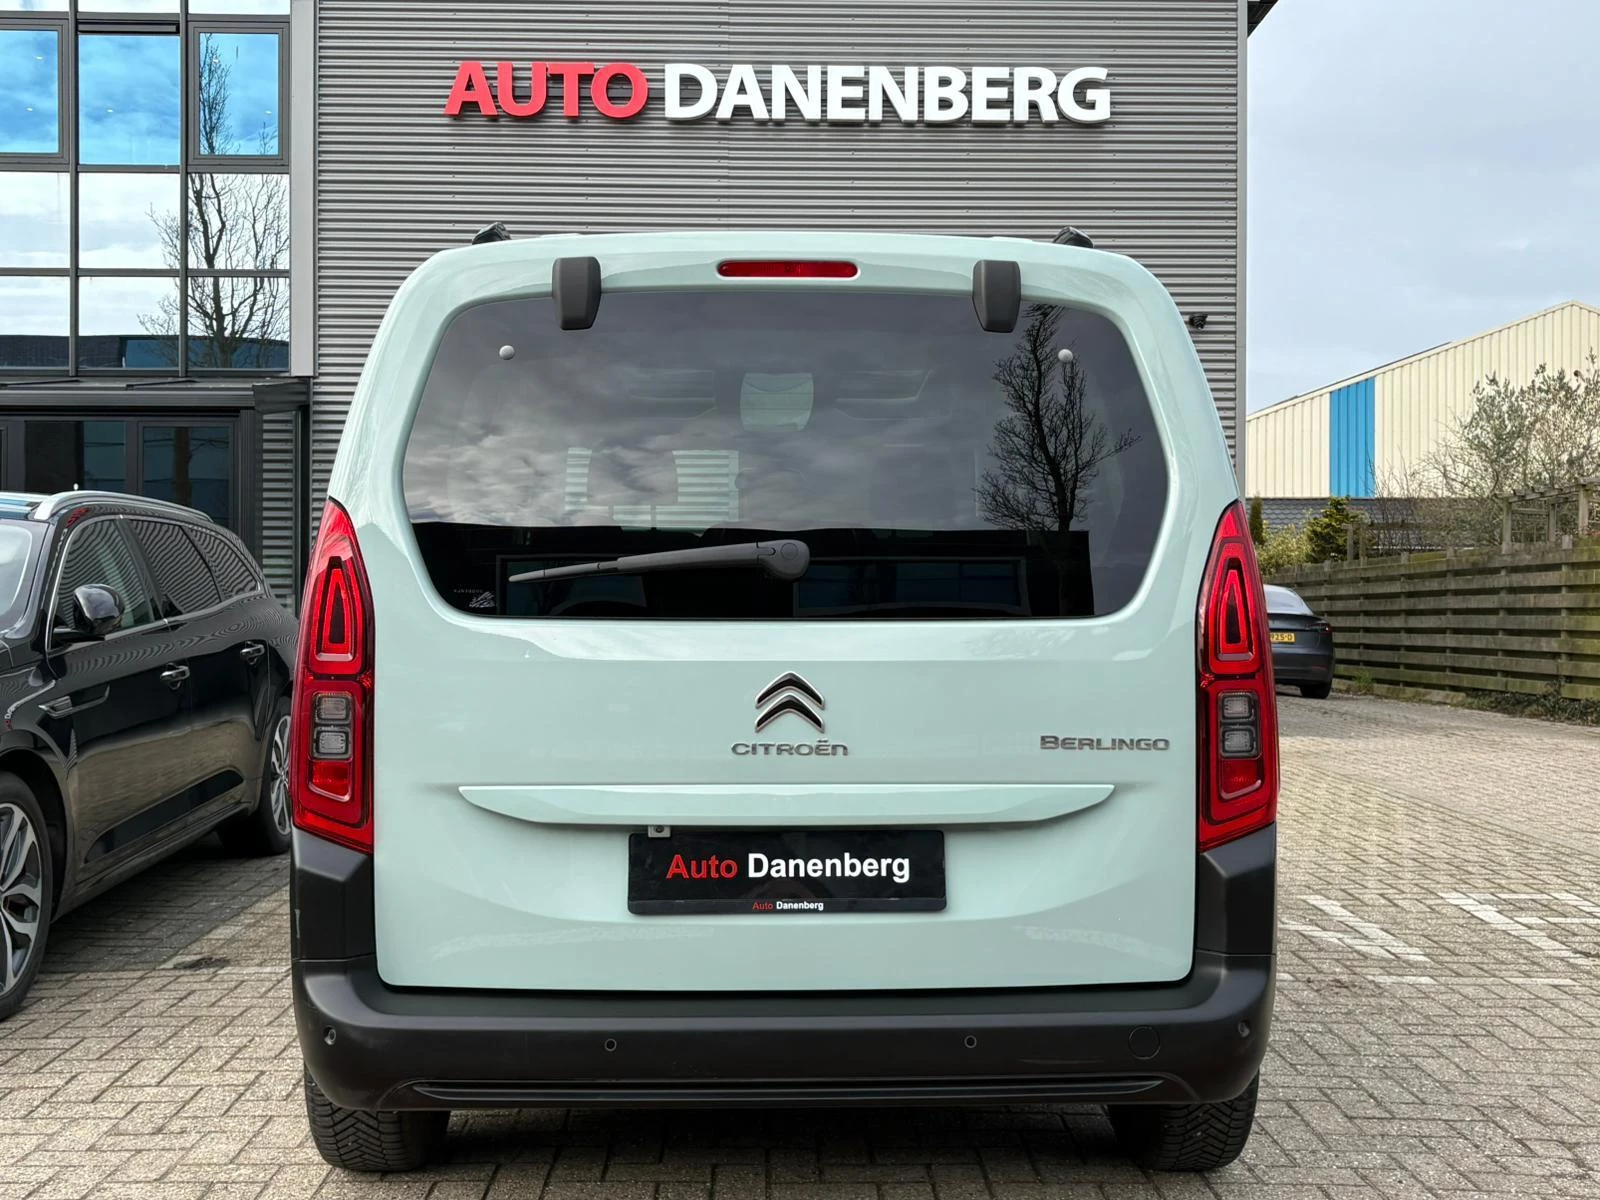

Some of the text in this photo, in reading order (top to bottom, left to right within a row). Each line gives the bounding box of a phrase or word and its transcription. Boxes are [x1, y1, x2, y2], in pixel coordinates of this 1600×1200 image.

[444, 60, 1111, 125] AUTO DANENBERG
[1040, 735, 1170, 751] BERLINGO
[666, 852, 910, 883] Auto Danenberg
[752, 901, 824, 911] Auto Danenberg
